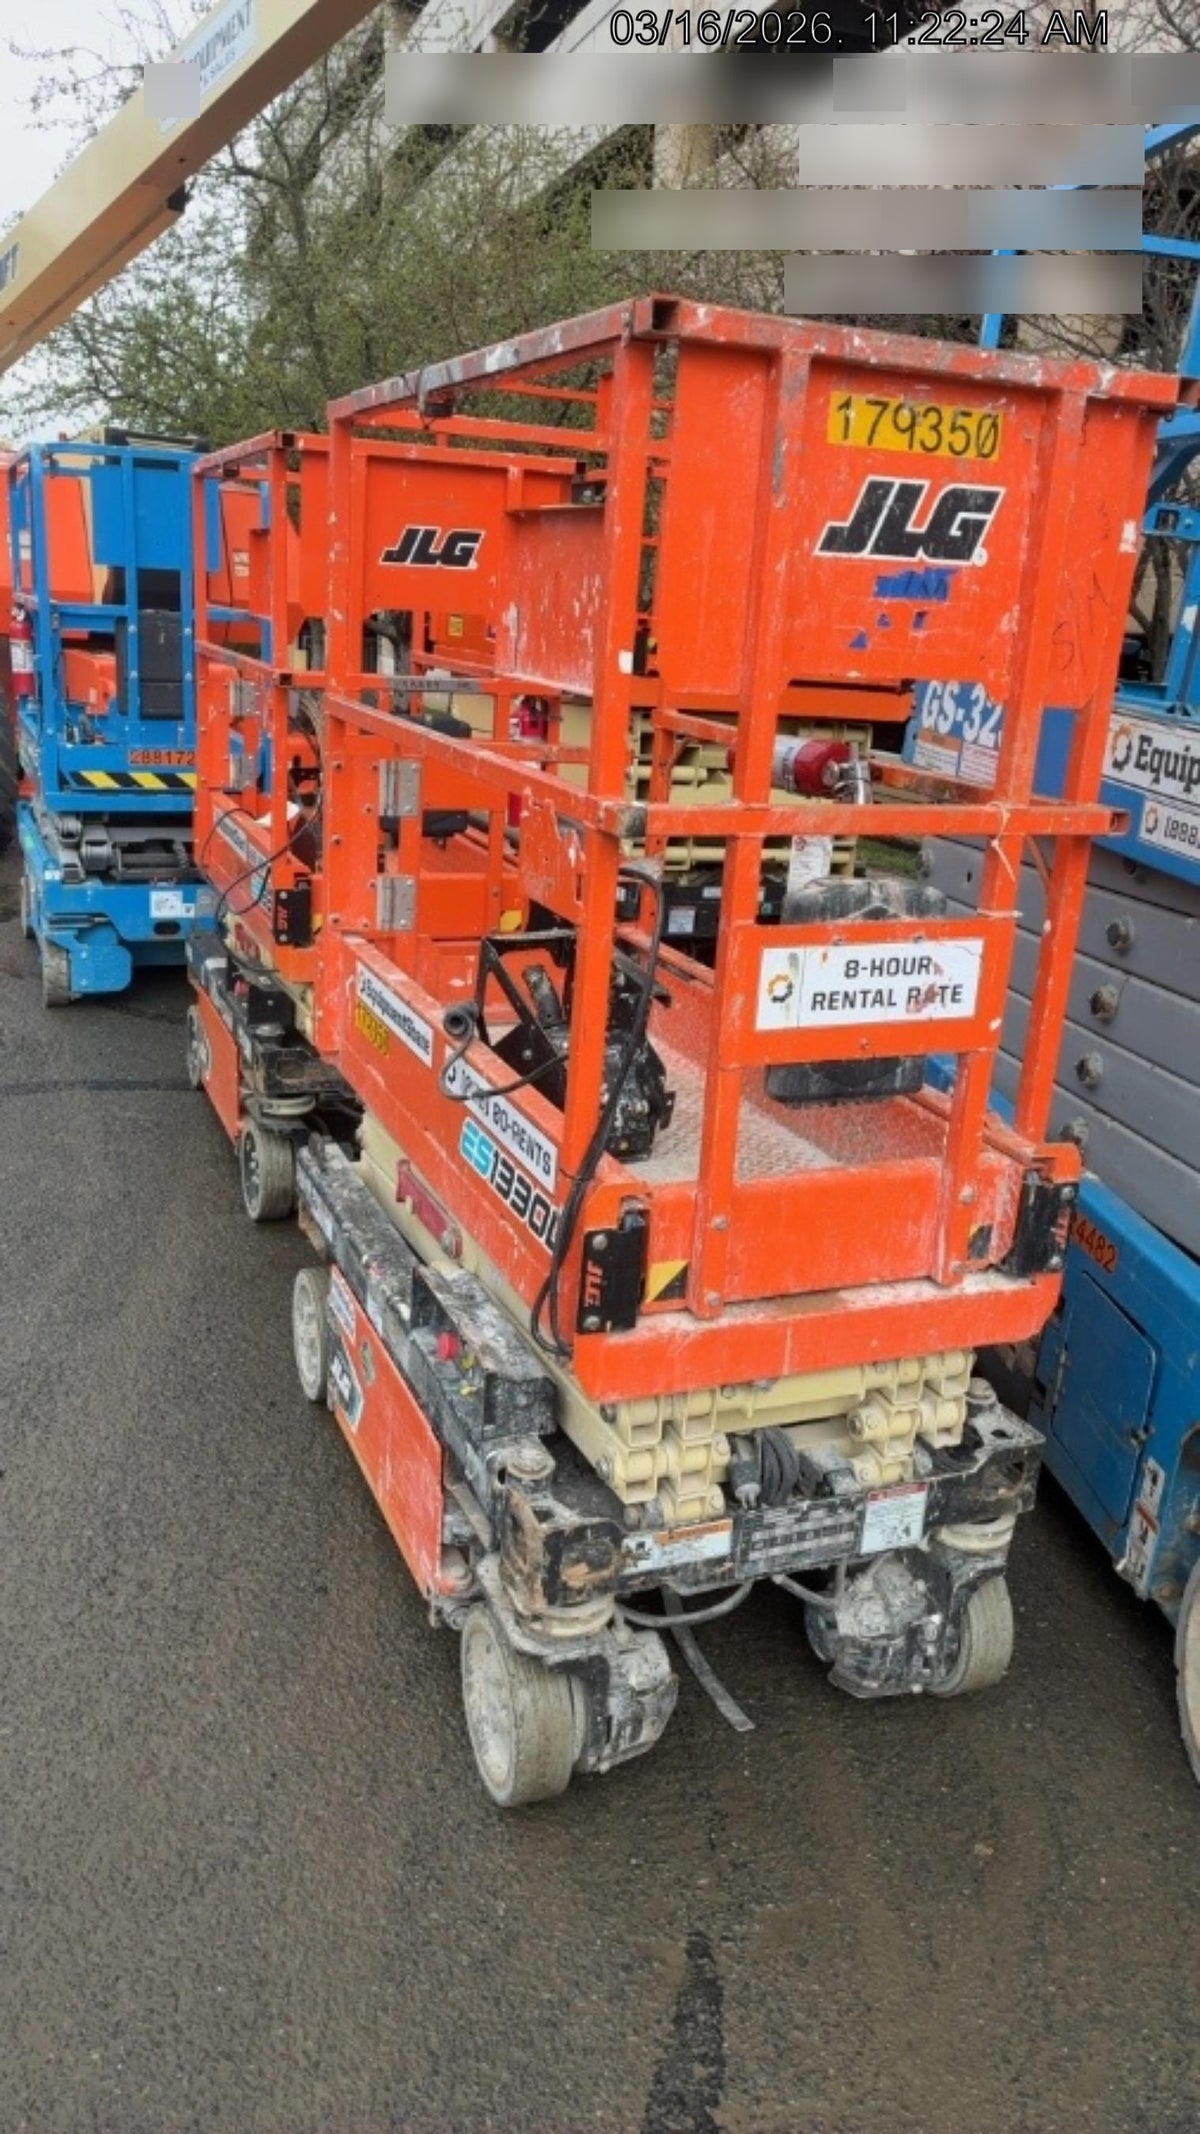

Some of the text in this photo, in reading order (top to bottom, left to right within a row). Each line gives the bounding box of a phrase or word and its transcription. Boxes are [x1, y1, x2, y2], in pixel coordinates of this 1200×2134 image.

[838, 396, 999, 458] 179350
[814, 475, 1006, 565] JLG
[379, 525, 485, 570] JLG
[922, 680, 1004, 748] GS-32
[1164, 815, 1200, 849] (888
[844, 956, 932, 979] 8-HOUR
[811, 988, 897, 1011] RENTAL
[583, 1259, 604, 1308] JLG
